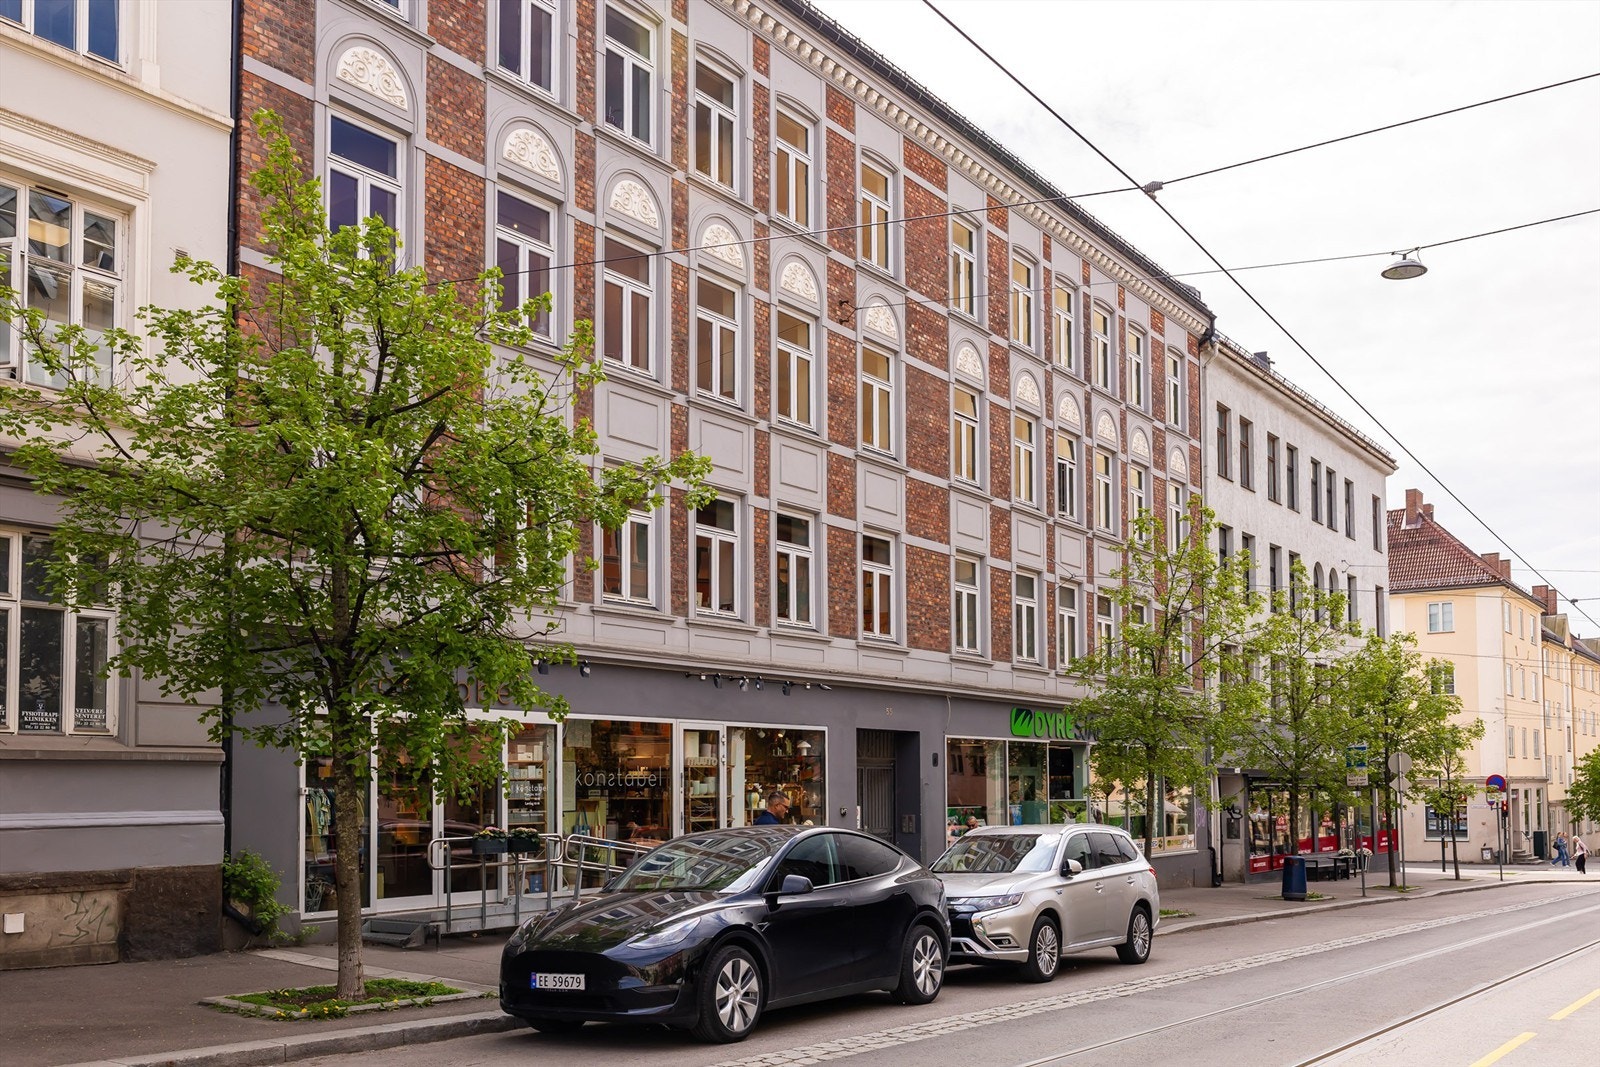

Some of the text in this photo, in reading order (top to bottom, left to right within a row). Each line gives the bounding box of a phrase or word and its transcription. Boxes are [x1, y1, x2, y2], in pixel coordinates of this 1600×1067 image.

[575, 766, 662, 787] konstabel
[538, 976, 581, 988] EE 59679
